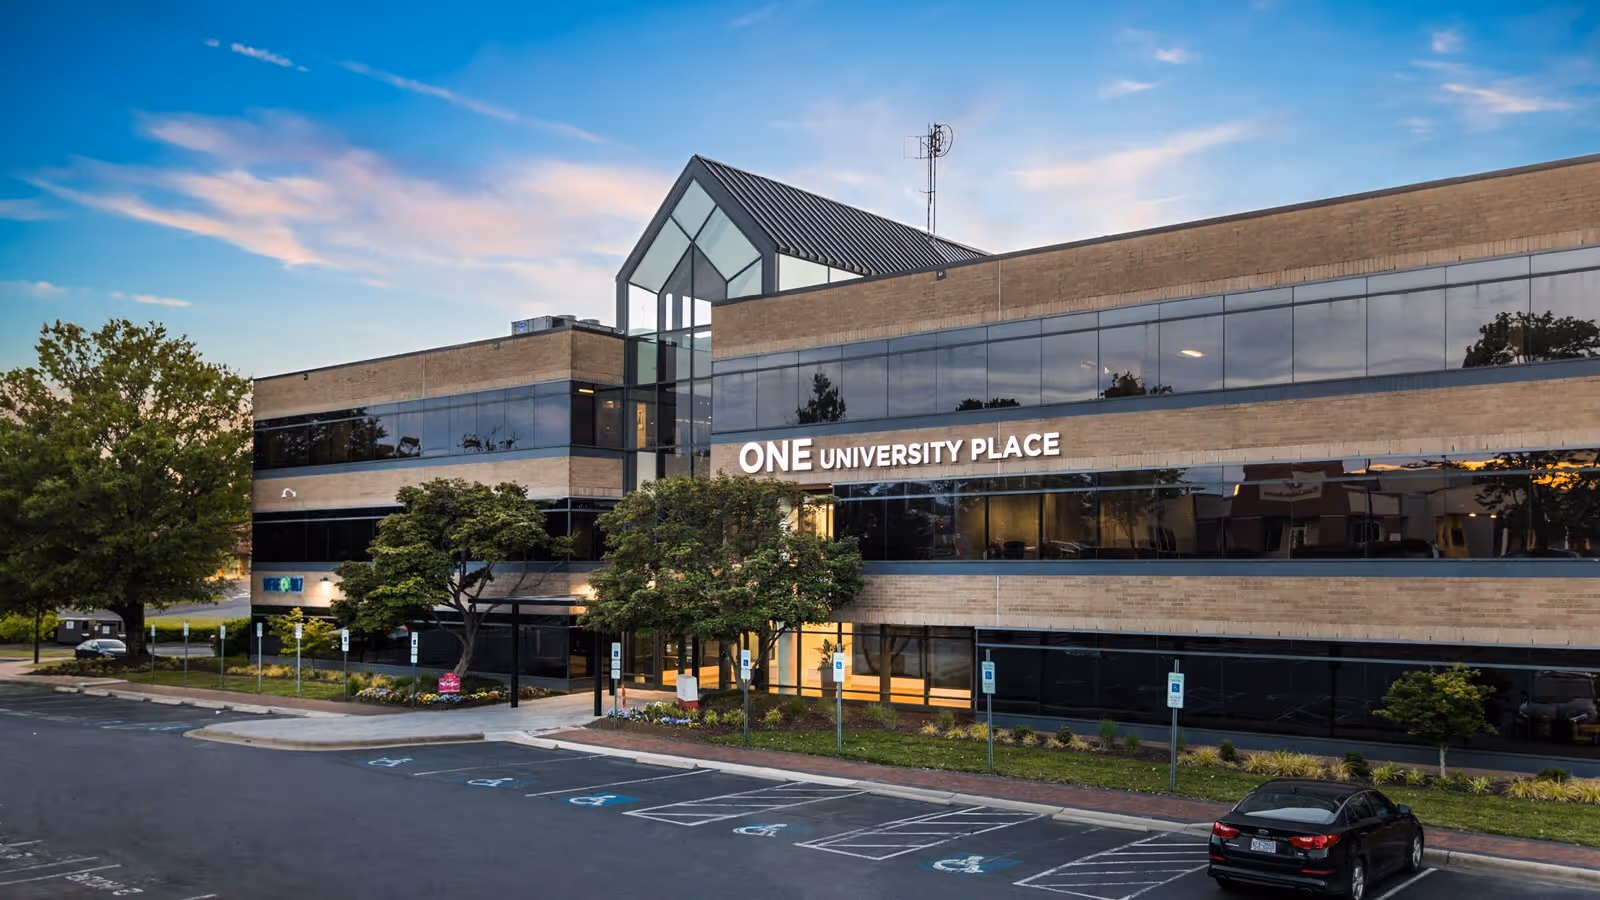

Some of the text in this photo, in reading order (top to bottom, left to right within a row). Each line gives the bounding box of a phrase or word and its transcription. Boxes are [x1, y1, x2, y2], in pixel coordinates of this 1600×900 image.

[738, 431, 1060, 474] ONE UNIVERSITY PLACE
